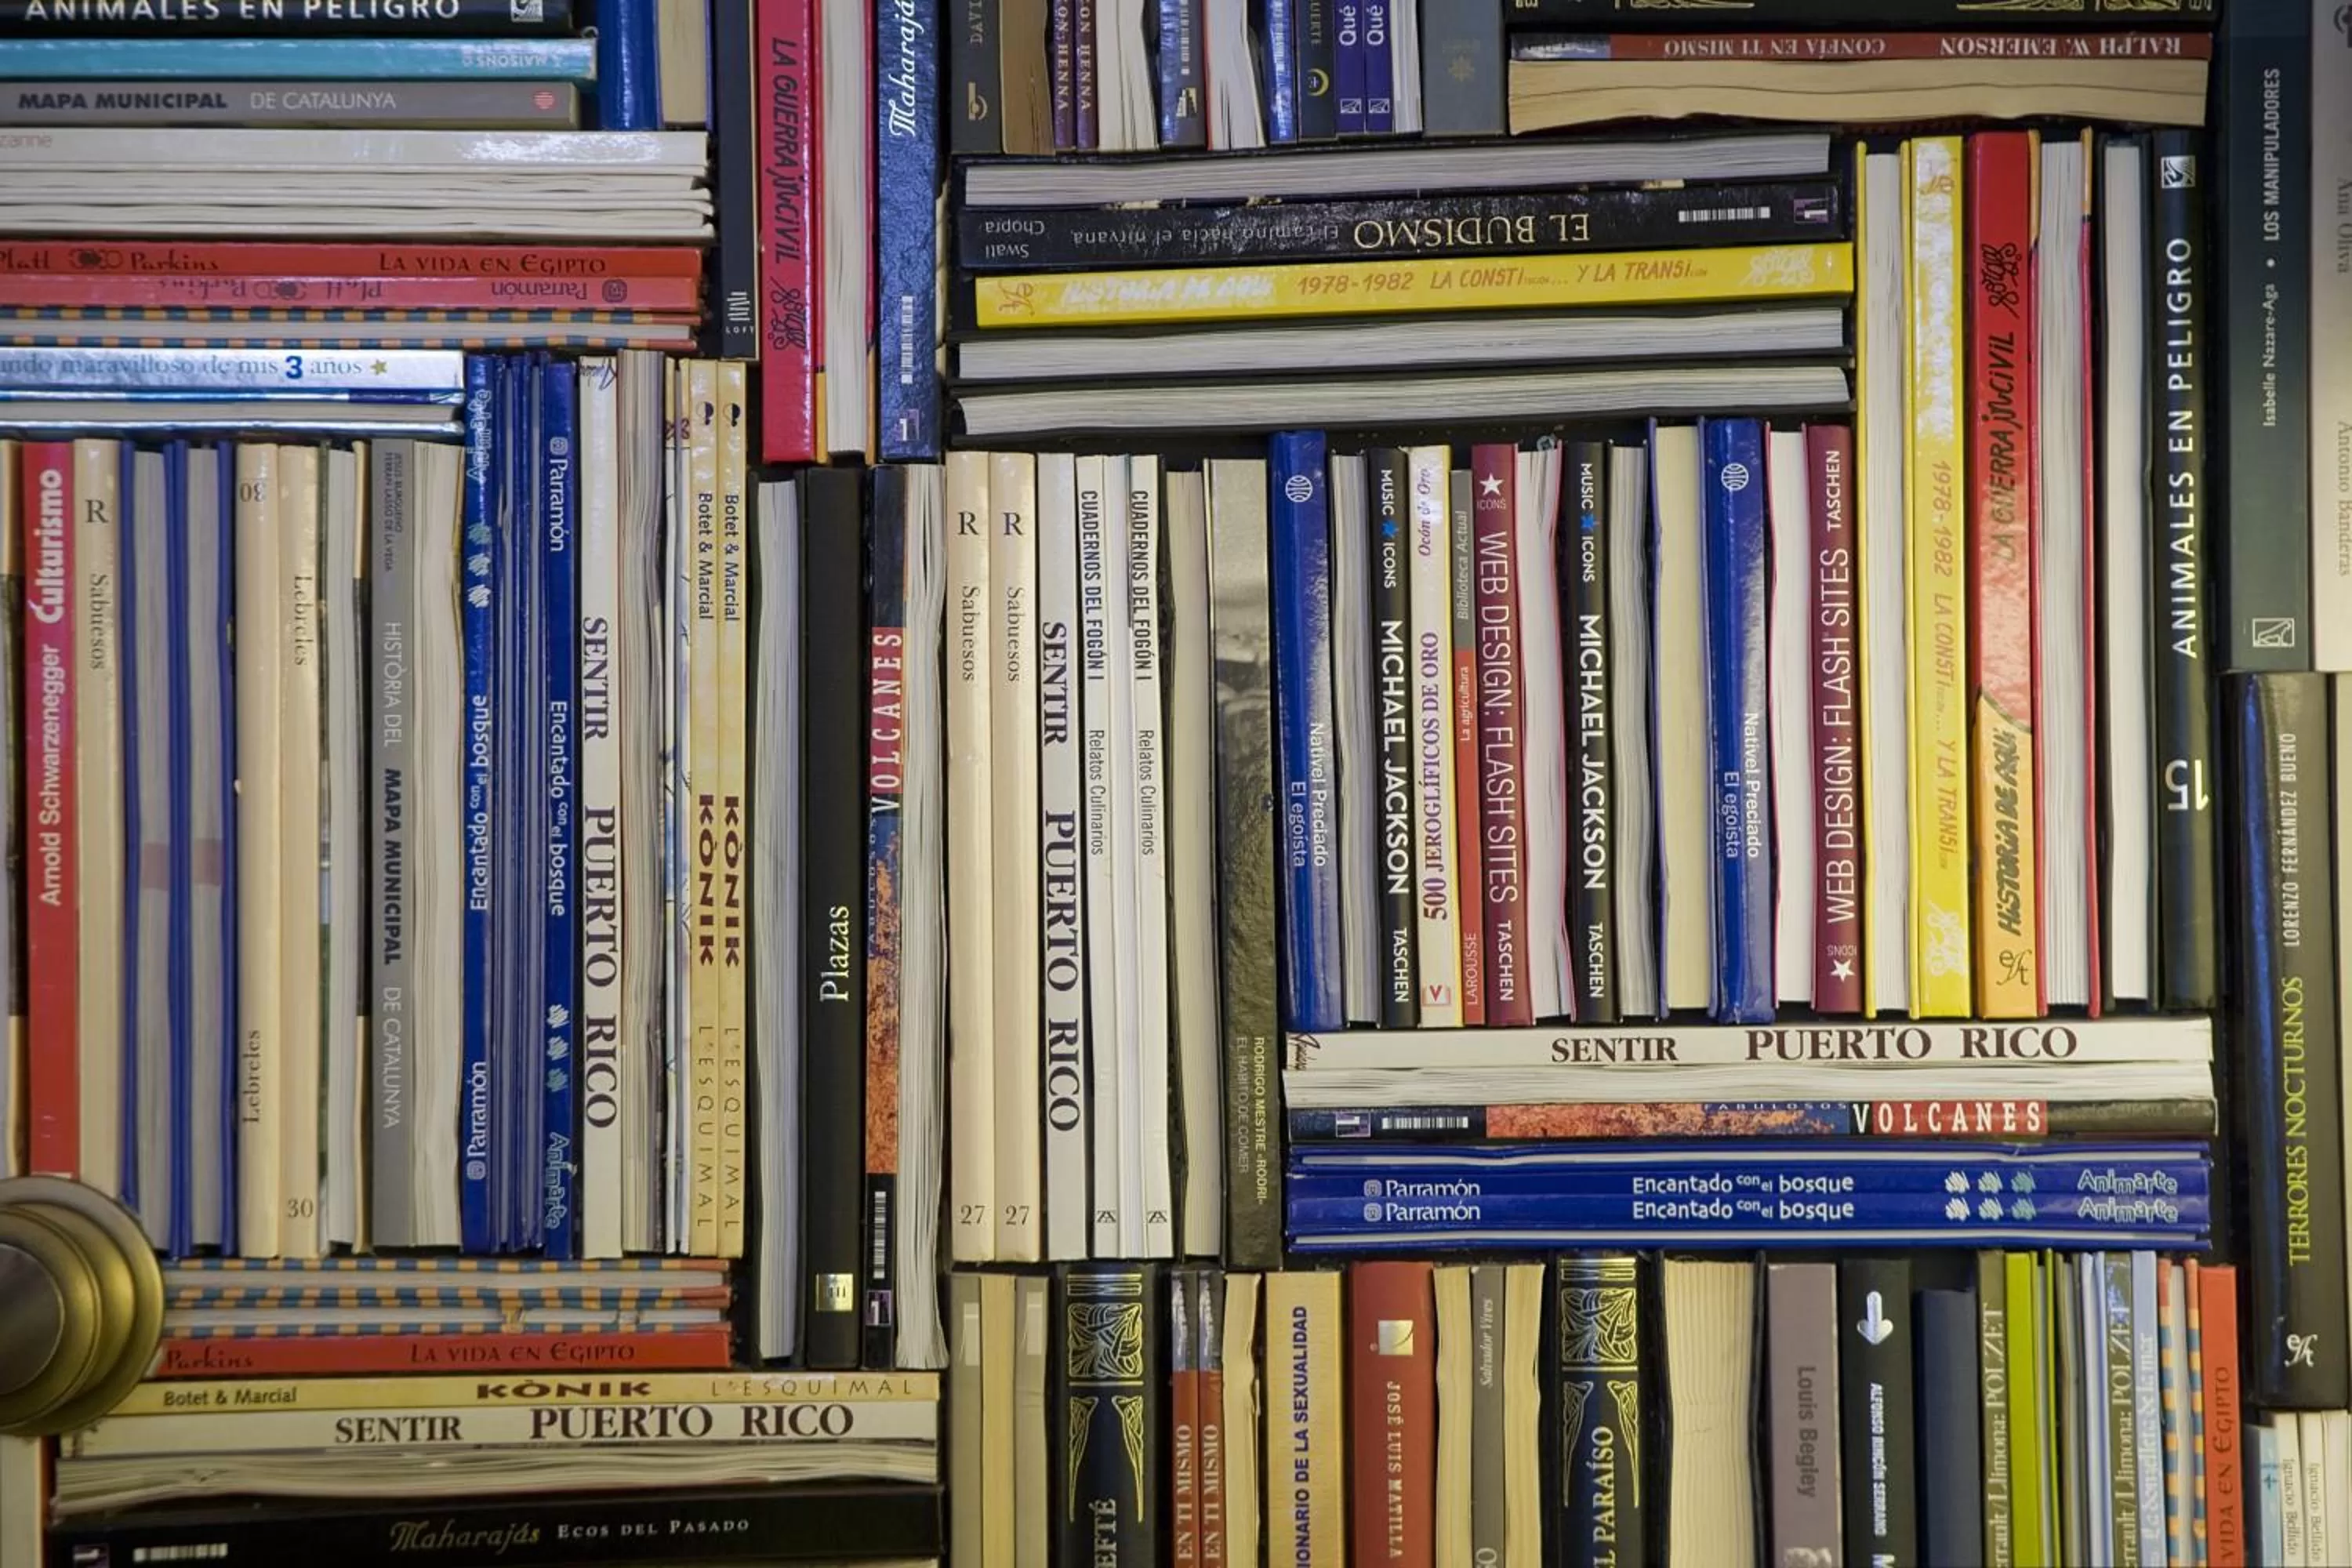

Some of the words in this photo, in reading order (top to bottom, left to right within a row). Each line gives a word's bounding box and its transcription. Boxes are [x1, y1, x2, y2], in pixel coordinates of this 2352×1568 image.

[1338, 5, 1356, 46] Qué
[1665, 38, 1733, 56] MISMO
[1741, 38, 1763, 56] TI
[1770, 38, 1798, 56] EN
[1807, 38, 1886, 60] CONFÍA
[1940, 37, 2057, 56] EMERSON
[2100, 36, 2182, 56] RALPH
[18, 93, 88, 109] MAPA
[95, 93, 227, 109] MUNICIPAL
[250, 92, 276, 109] DE
[283, 91, 397, 109] CATALUNYA
[2264, 68, 2280, 205] MANIPULADORES
[985, 220, 1046, 236] Chopra
[1354, 214, 1535, 248] BUDISMO
[1549, 213, 1590, 241] EL
[2264, 212, 2280, 241] LOS
[131, 251, 220, 271] Parkins
[379, 253, 405, 271] LA
[416, 256, 470, 272] VIDA
[480, 258, 510, 272] EN
[520, 252, 606, 275] EGIPTO
[491, 281, 587, 301] Parramón
[2166, 238, 2193, 390] PELIGRO
[2263, 284, 2280, 368] Nazare-Aga
[61, 355, 195, 376] maravilloso
[201, 356, 232, 376] de
[238, 357, 278, 375] mis
[285, 355, 303, 379] 3
[310, 357, 362, 376] años
[2263, 372, 2275, 426] Isabelle
[2169, 412, 2193, 452] EN
[85, 499, 109, 524] R
[549, 458, 568, 552] Parramón
[1381, 470, 1394, 515] MUSIC
[1477, 499, 1507, 510] ICONS
[1580, 463, 1593, 510] MUSIC
[724, 494, 739, 538] Botet
[958, 512, 979, 535] R
[1081, 490, 1101, 581] CUADERNOS
[1457, 510, 1468, 552] Actual
[28, 470, 64, 624] Culturismo
[724, 542, 738, 556] &
[1383, 542, 1397, 588] ICONS
[1480, 531, 1509, 595] WEB
[1582, 535, 1595, 583] ICONS
[2169, 472, 2198, 658] ANIMALES
[724, 560, 740, 622] Marcial
[1084, 586, 1102, 614] DEL
[1457, 553, 1469, 620] Biblioteca
[89, 573, 116, 670] Sabuesos
[962, 585, 980, 681] Sabuesos
[1087, 620, 1105, 671] FOGÓN
[384, 622, 405, 710] HISTÒRIA
[583, 617, 611, 740] SENTIR
[1421, 632, 1439, 679] ORO
[1482, 605, 1512, 716] DESIGN:
[1579, 615, 1606, 746] MICHAEL
[1042, 622, 1069, 746] SENTIR
[1381, 620, 1406, 751] MICHAEL
[1421, 684, 1440, 710] DE
[1460, 666, 1474, 722] agricultura
[39, 644, 66, 826] Schwarzenegger
[384, 715, 401, 747] DEL
[550, 701, 571, 798] Encantado
[872, 633, 902, 813] VOLCANES
[1461, 724, 1471, 741] La
[1744, 712, 1760, 775] Nativel
[1089, 730, 1105, 781] Relatos
[1485, 727, 1515, 815] FLASH
[1724, 771, 1740, 786] El
[2280, 732, 2296, 781] BUENO
[384, 769, 402, 832] MAPA
[1418, 713, 1446, 872] JEROGLÍFICOS
[2165, 760, 2209, 811] 15
[550, 826, 562, 837] el
[558, 802, 568, 826] con
[1090, 785, 1107, 855] Culinarios
[1384, 760, 1409, 895] JACKSON
[1582, 754, 1606, 890] JACKSON
[1722, 791, 1740, 858] egoísta
[1747, 779, 1762, 858] Preciado
[2277, 790, 2299, 872] FERNÁNDEZ
[39, 832, 62, 906] Arnold
[548, 842, 568, 916] bosque
[1488, 826, 1518, 903] SITES
[384, 840, 402, 966] MUNICIPAL
[584, 805, 619, 987] PUERTO
[1045, 811, 1080, 991] PUERTO
[1423, 877, 1447, 920] 500
[2283, 883, 2300, 947] LORENZO
[819, 904, 850, 1003] Plazas
[1392, 927, 1409, 1003] TASCHEN
[1464, 933, 1479, 1004] LAROUSSE
[1497, 920, 1514, 1001] TASCHEN
[1588, 922, 1603, 998] TASCHEN
[383, 987, 401, 1011] DE
[586, 1014, 618, 1128] RICO
[1254, 1036, 1264, 1096] RODRIGO
[1552, 1036, 1679, 1063] SENTIR
[1745, 1027, 1932, 1061] PUERTO
[1960, 1026, 2078, 1058] RICO
[2282, 976, 2307, 1138] NOCTURNOS
[242, 1030, 260, 1123] Lebreles
[383, 1019, 401, 1128] CATALUNYA
[1048, 1018, 1080, 1132] RICO
[1254, 1098, 1265, 1151] MESTRE
[1853, 1102, 2041, 1134] VOLCANES
[288, 1199, 314, 1218] 30
[1386, 1179, 1481, 1198] Parramón
[1633, 1174, 1733, 1194] Encantado
[1737, 1174, 1760, 1186] con
[1761, 1181, 1773, 1192] el
[1779, 1174, 1854, 1194] bosque
[2078, 1169, 2178, 1195] Animarte
[2286, 1145, 2310, 1266] TERRORES
[960, 1204, 985, 1225] 27
[165, 1346, 253, 1370] Parkins
[411, 1343, 437, 1363] LA
[447, 1346, 501, 1363] VIDA
[510, 1345, 541, 1363] EN
[550, 1341, 635, 1365] EGIPTO
[1293, 1306, 1308, 1423] SEXUALIDAD
[1983, 1303, 2006, 1409] POLZET
[164, 1389, 211, 1407] Botet
[215, 1389, 227, 1406] &
[234, 1386, 297, 1405] Marcial
[1387, 1381, 1404, 1425] JOSÉ
[1798, 1366, 1818, 1420] Louis
[335, 1415, 463, 1444] SENTIR
[529, 1403, 713, 1441] PUERTO
[740, 1403, 855, 1437] RICO
[1294, 1428, 1309, 1452] LA
[1176, 1424, 1192, 1494] MISMO
[1294, 1455, 1310, 1483] DE
[1387, 1432, 1403, 1472] LUIS
[1795, 1428, 1820, 1498] Begley
[1585, 1426, 1617, 1543] PARAÍSO
[390, 1520, 541, 1555] Maharajás
[1177, 1503, 1192, 1525] TI
[1388, 1479, 1404, 1559] MATILLA
[1177, 1531, 1192, 1561] EN
